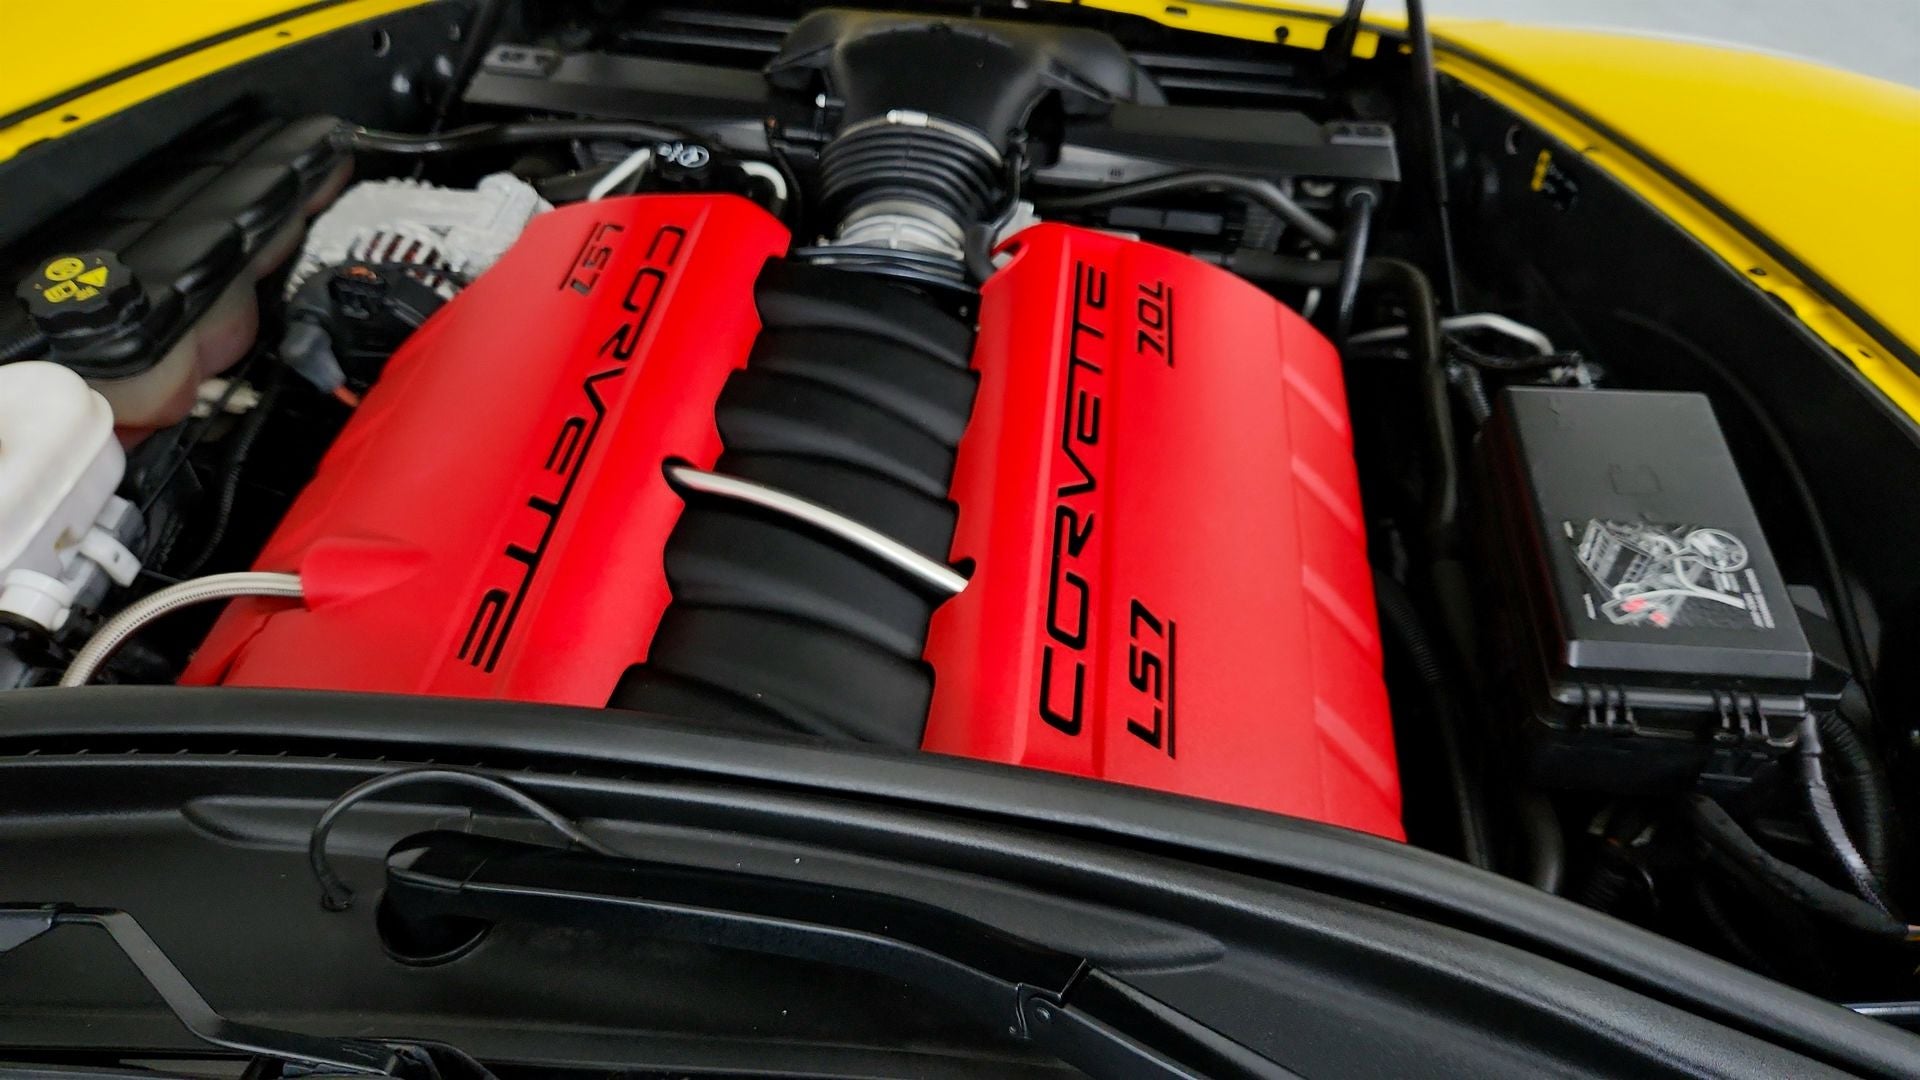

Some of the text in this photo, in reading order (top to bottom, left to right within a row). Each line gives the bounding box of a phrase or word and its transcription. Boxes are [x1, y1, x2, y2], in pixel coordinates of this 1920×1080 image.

[570, 223, 624, 295] LS7
[457, 225, 686, 674] CORVETTE
[1039, 260, 1107, 736] CORVETTE
[1127, 598, 1163, 749] LS7
